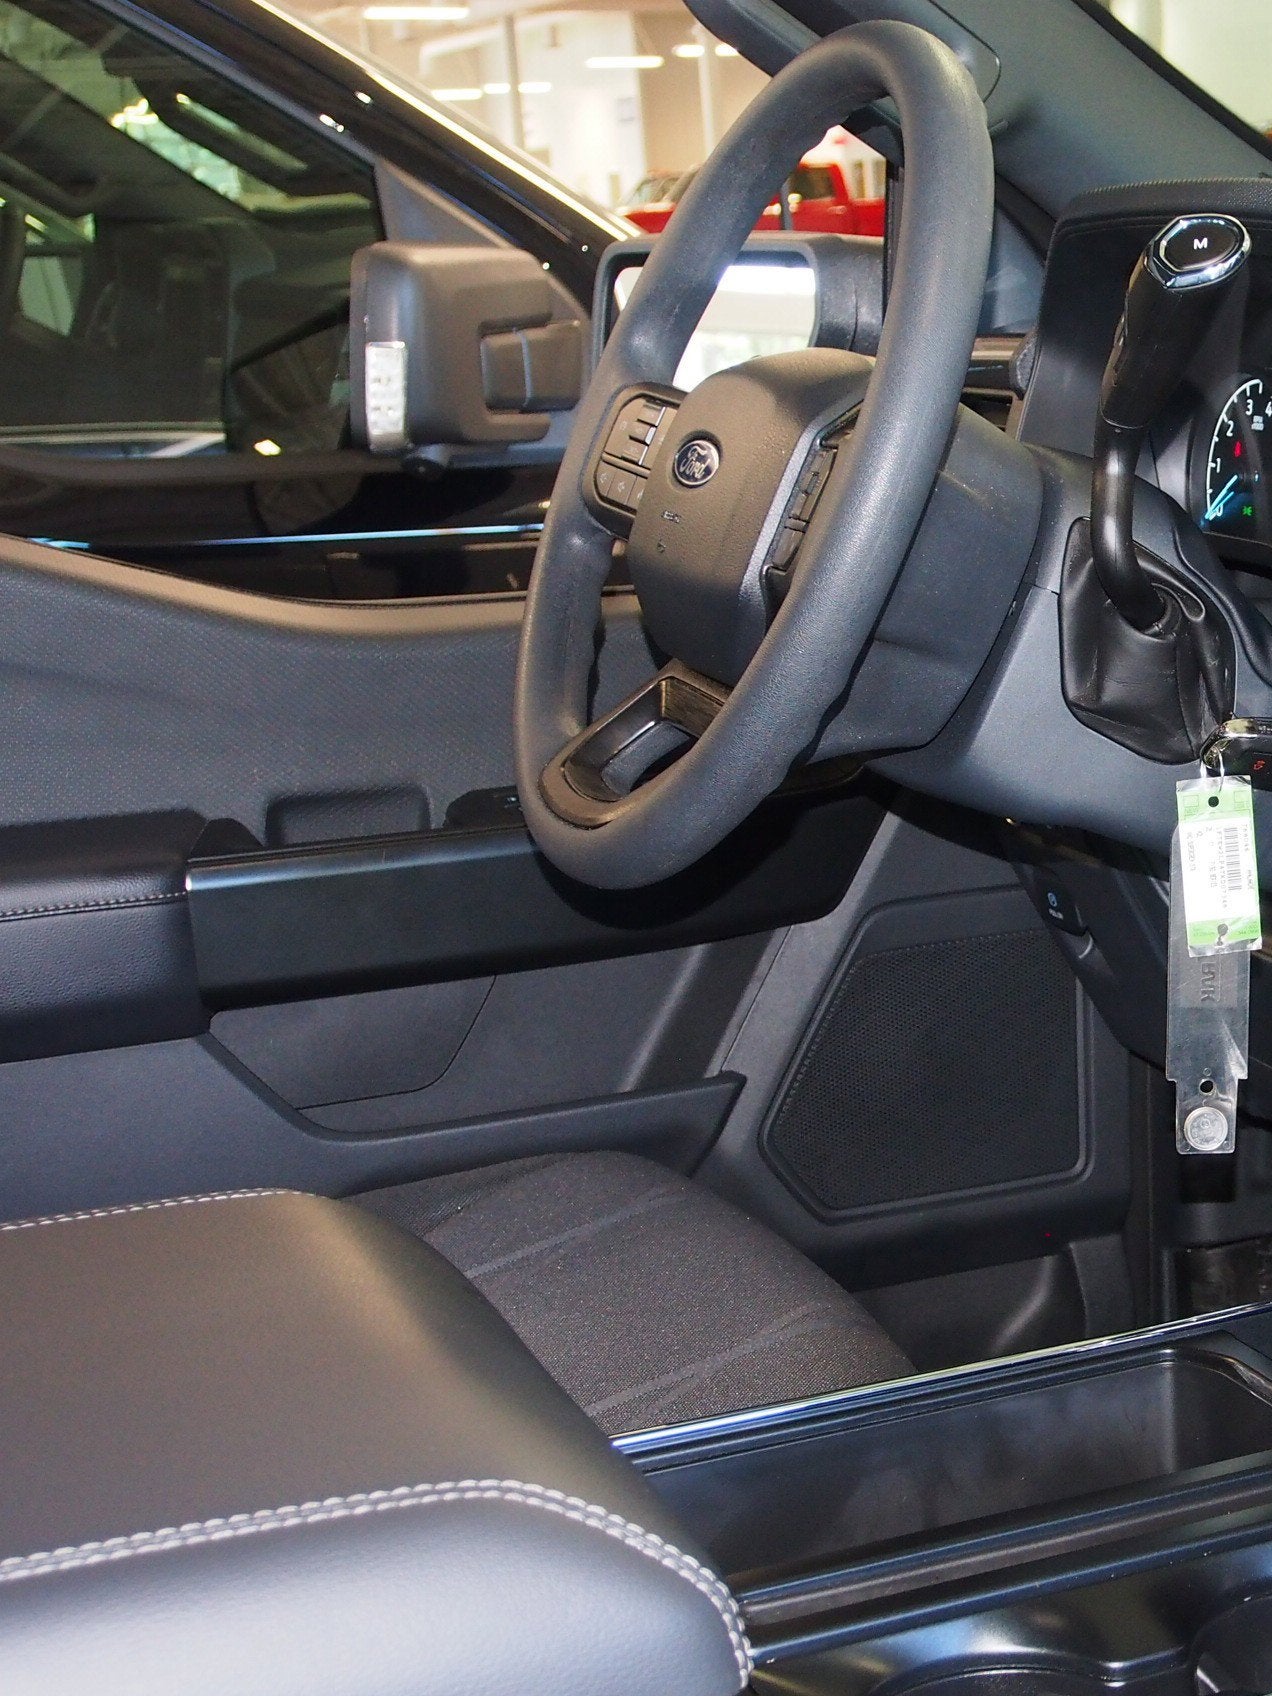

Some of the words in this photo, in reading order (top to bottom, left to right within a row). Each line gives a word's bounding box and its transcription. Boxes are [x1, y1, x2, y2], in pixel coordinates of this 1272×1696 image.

[1193, 237, 1208, 250] M
[1245, 399, 1253, 416] 3
[1265, 401, 1272, 417] 4
[1226, 420, 1234, 437] 2
